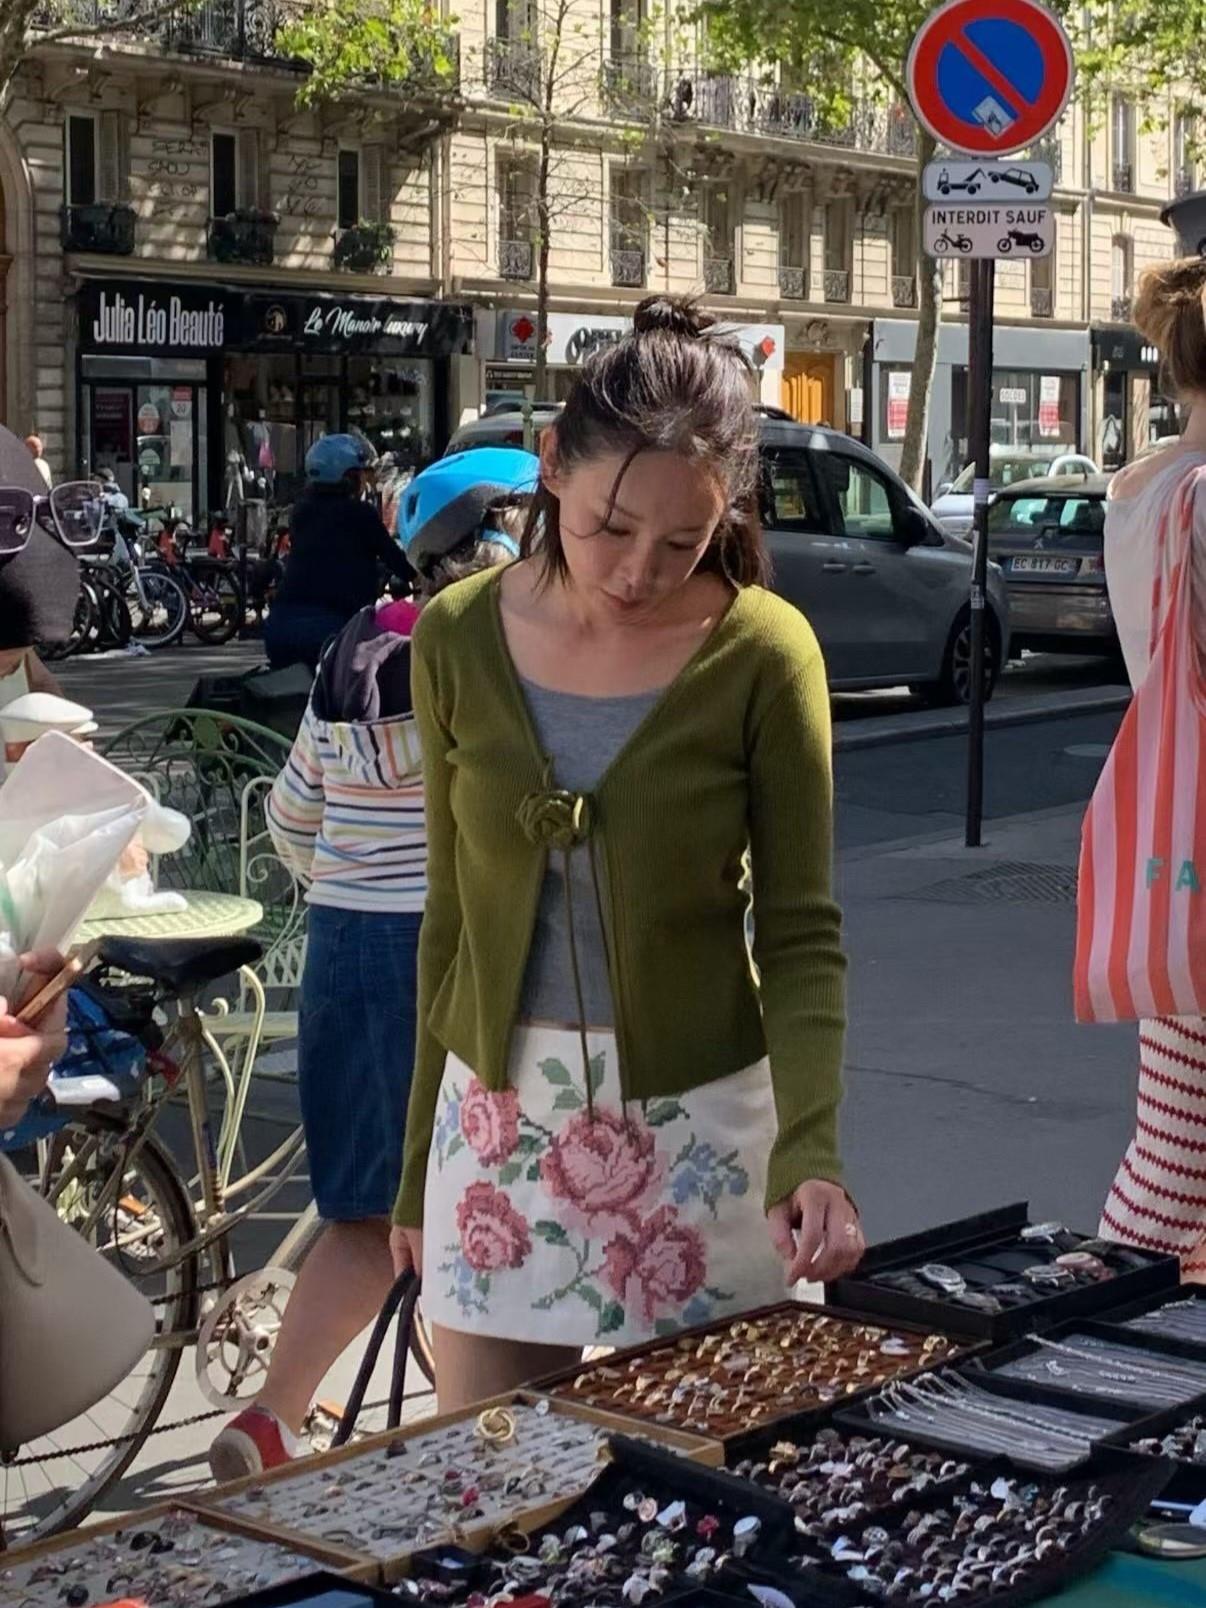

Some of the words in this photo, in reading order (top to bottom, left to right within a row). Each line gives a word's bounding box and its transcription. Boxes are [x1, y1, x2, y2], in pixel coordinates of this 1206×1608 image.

[932, 210, 1000, 224] INTERDIT
[1005, 210, 1046, 224] SAUF
[93, 291, 135, 342] Julia
[138, 293, 166, 344] Léo
[169, 296, 224, 346] Beauté
[304, 306, 324, 336] Le
[325, 306, 382, 337] Manoir
[1014, 559, 1027, 570] EC
[1030, 559, 1050, 570] 817
